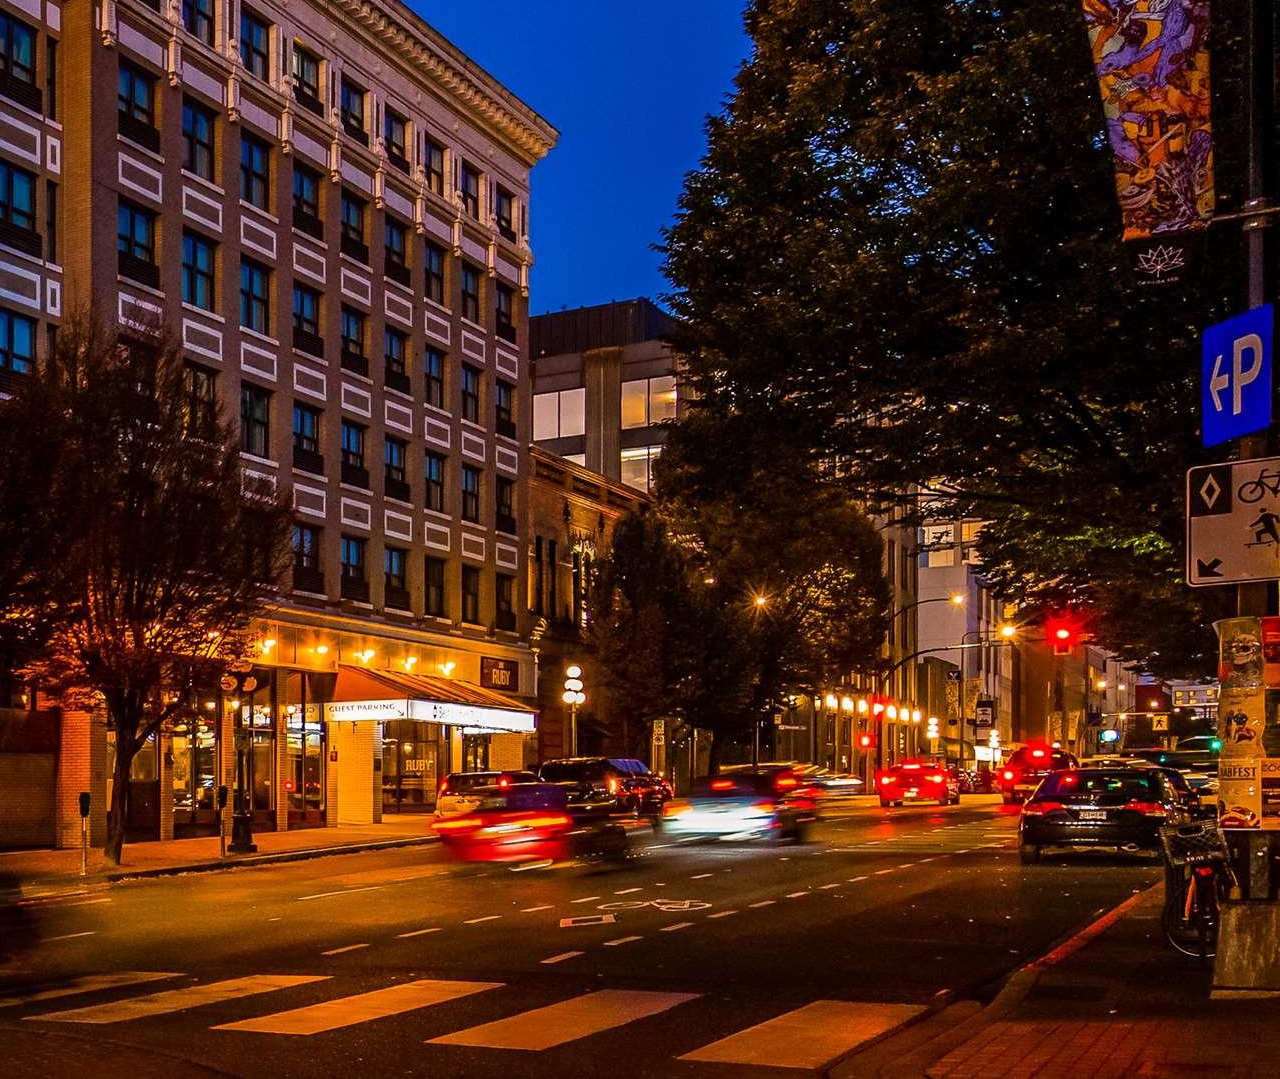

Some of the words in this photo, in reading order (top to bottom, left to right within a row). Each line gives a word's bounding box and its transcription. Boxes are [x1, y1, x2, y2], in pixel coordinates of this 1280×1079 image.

[1233, 333, 1263, 415] P
[328, 700, 355, 713] GUEST
[356, 698, 395, 711] PARKING
